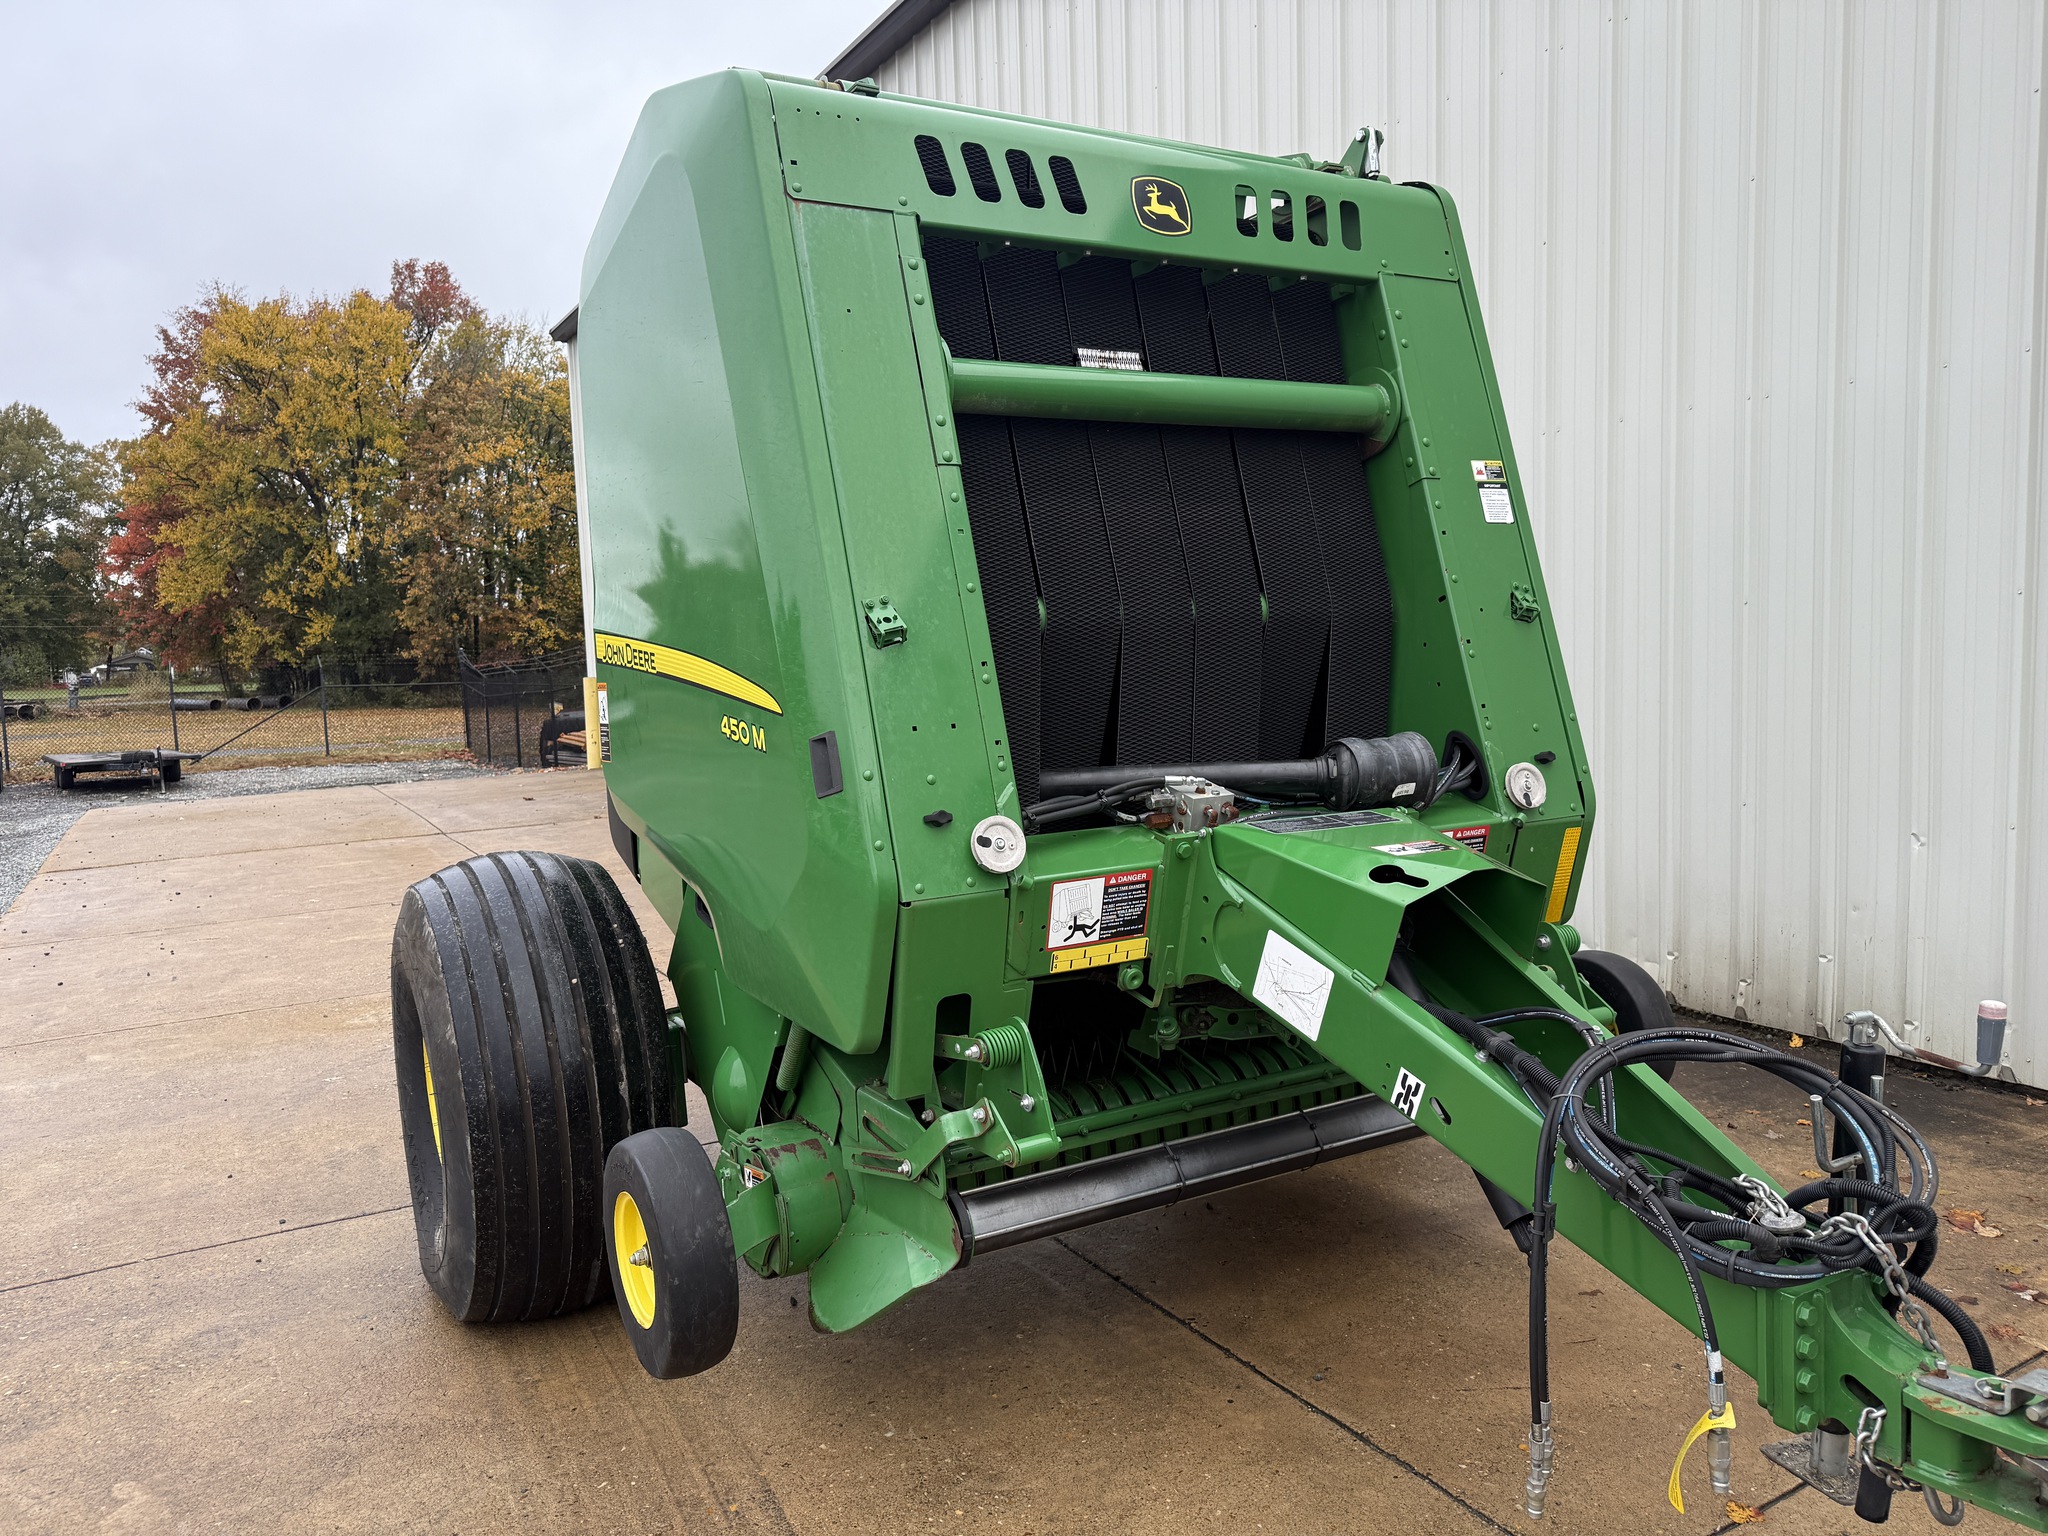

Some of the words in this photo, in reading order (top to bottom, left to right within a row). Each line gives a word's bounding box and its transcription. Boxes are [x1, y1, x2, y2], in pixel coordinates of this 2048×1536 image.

[603, 640, 624, 662] JOHN
[626, 643, 657, 671] DEERE
[721, 714, 750, 746] 450
[752, 723, 767, 753] M
[1462, 828, 1486, 836] DANGER
[1118, 872, 1147, 882] DANGER
